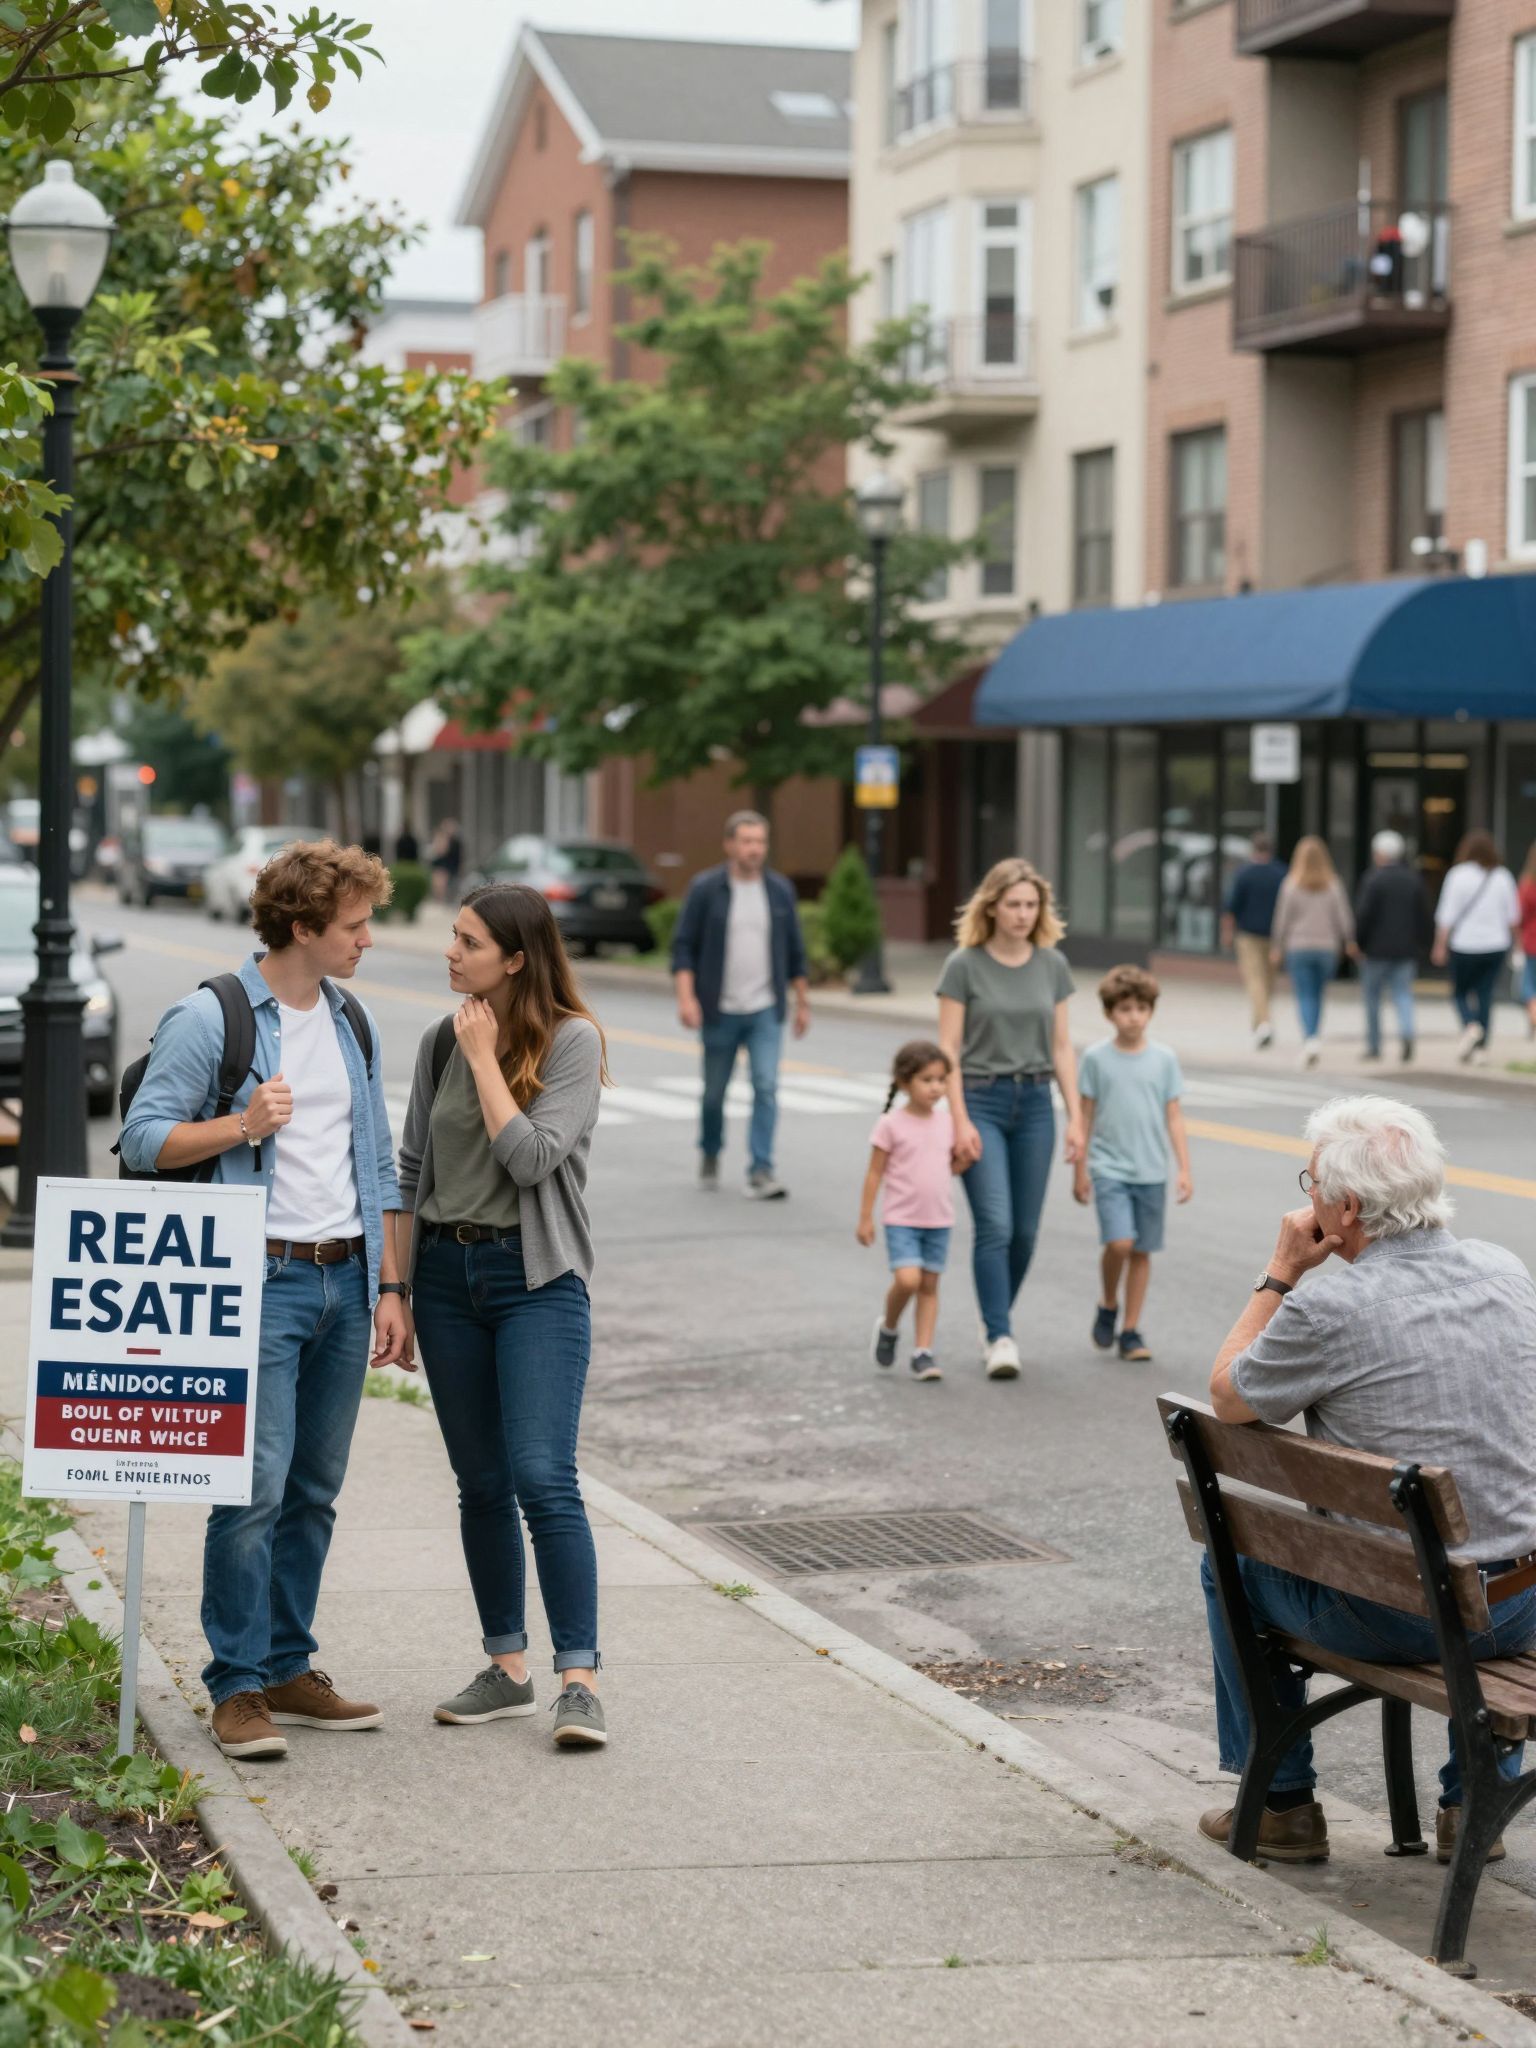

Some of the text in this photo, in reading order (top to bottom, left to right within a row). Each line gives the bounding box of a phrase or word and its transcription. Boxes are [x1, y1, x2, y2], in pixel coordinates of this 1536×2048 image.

[68, 1209, 232, 1269] REAL
[49, 1276, 242, 1338] ESATE
[181, 1376, 227, 1397] FOR
[61, 1404, 112, 1421] BOUL
[118, 1406, 144, 1422] OF
[70, 1427, 208, 1447] QUENR WHCE
